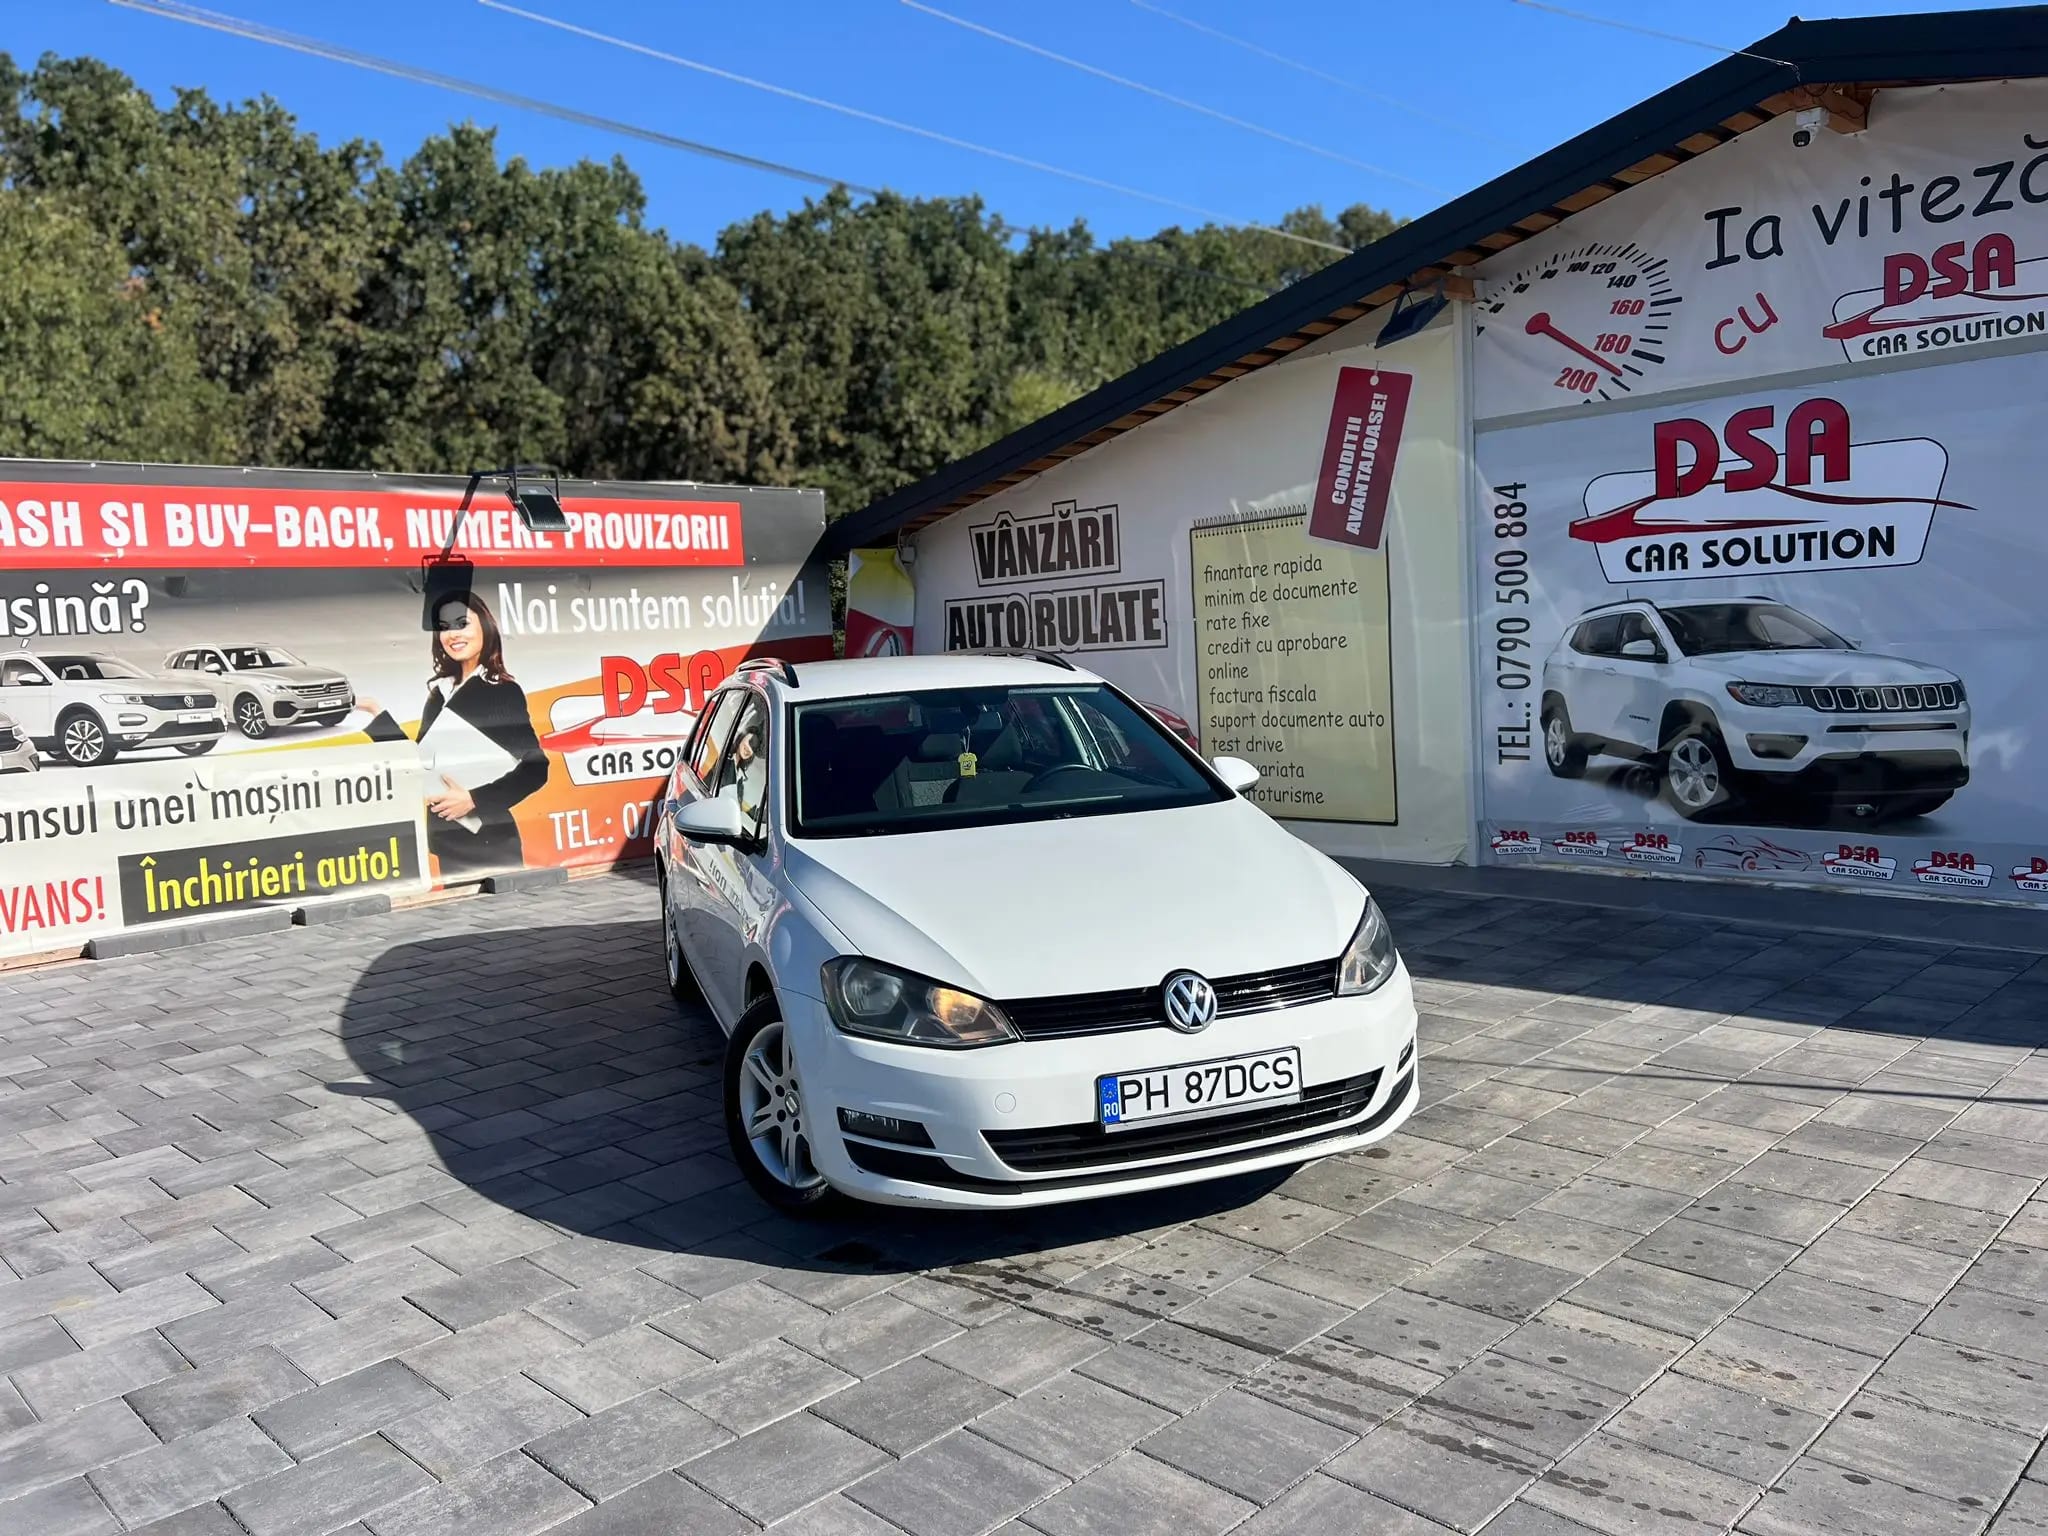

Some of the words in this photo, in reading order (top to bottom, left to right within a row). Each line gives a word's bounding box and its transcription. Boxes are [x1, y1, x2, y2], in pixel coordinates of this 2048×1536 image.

[1704, 206, 1784, 270] Ia
[1812, 133, 2048, 246] viteză
[1566, 261, 1590, 273] 100
[1590, 262, 1617, 275] 120
[1883, 232, 2016, 307] DSA
[1607, 274, 1637, 289] 140
[1609, 299, 1646, 315] 160
[1714, 292, 1779, 354] cu
[1863, 332, 1908, 357] CAR
[1917, 311, 2046, 350] SOLUTION
[1593, 333, 1632, 354] 180
[1554, 367, 1599, 393] 200
[1332, 416, 1363, 505] CONDITII
[1654, 397, 1851, 499] DSA
[1345, 392, 1388, 536] AVANTAJOASE!
[1494, 482, 1528, 538] 884
[101, 501, 148, 558] ȘI
[164, 503, 394, 551] BUY-BACK,
[563, 511, 729, 550] PROVIZORII
[975, 508, 1115, 580] VÂNZĂRI
[1624, 542, 1689, 574] CAR
[1701, 525, 1895, 570] SOLUTION
[1204, 562, 1269, 583] finantare
[1273, 554, 1323, 579] rapida
[1494, 550, 1530, 604] 500
[1204, 588, 1244, 607] minim
[1250, 586, 1268, 603] de
[1272, 579, 1358, 601] documente
[498, 583, 559, 635] Noi
[571, 586, 690, 633] suntem
[949, 599, 1027, 651] AUTO
[1034, 588, 1162, 647] RULATE
[1206, 615, 1237, 631] rate
[1241, 611, 1271, 629] fixe
[1207, 637, 1251, 655] credit
[1256, 639, 1273, 653] cu
[1277, 633, 1348, 656] aprobare
[1496, 617, 1531, 690] 0790
[600, 649, 724, 718] DSA
[1208, 662, 1249, 680] online
[1209, 687, 1263, 704] factura
[1268, 684, 1317, 703] fiscala
[1210, 712, 1256, 732] suport
[1261, 710, 1344, 728] documente
[1349, 711, 1385, 728] auto
[1498, 702, 1531, 765] TEL.:
[1211, 737, 1241, 752] test
[1246, 736, 1284, 752] drive
[587, 751, 633, 776] CAR
[114, 782, 196, 830] unei
[211, 769, 321, 824] mașini
[335, 761, 394, 806] noi!
[548, 808, 615, 851] TEL.:
[1500, 829, 1530, 842] DSA
[1565, 831, 1598, 844] DSA
[1634, 832, 1669, 849] DSA
[1561, 847, 1573, 855] CAR
[1574, 847, 1604, 856] SOLUTION
[1643, 854, 1676, 862] SOLUTION
[1838, 844, 1880, 864] DSA
[1931, 851, 1975, 870] DSA
[140, 850, 306, 914] Închirieri
[316, 836, 401, 889] auto!
[1831, 866, 1847, 874] CAR
[1847, 867, 1888, 878] SOLUTION
[1924, 875, 1940, 883] CAR
[1941, 876, 1984, 886] SOLUTION
[2023, 881, 2040, 890] CAR
[1119, 1074, 1169, 1115] PH
[1185, 1056, 1294, 1104] 87DCS
[1104, 1102, 1119, 1118] RO
